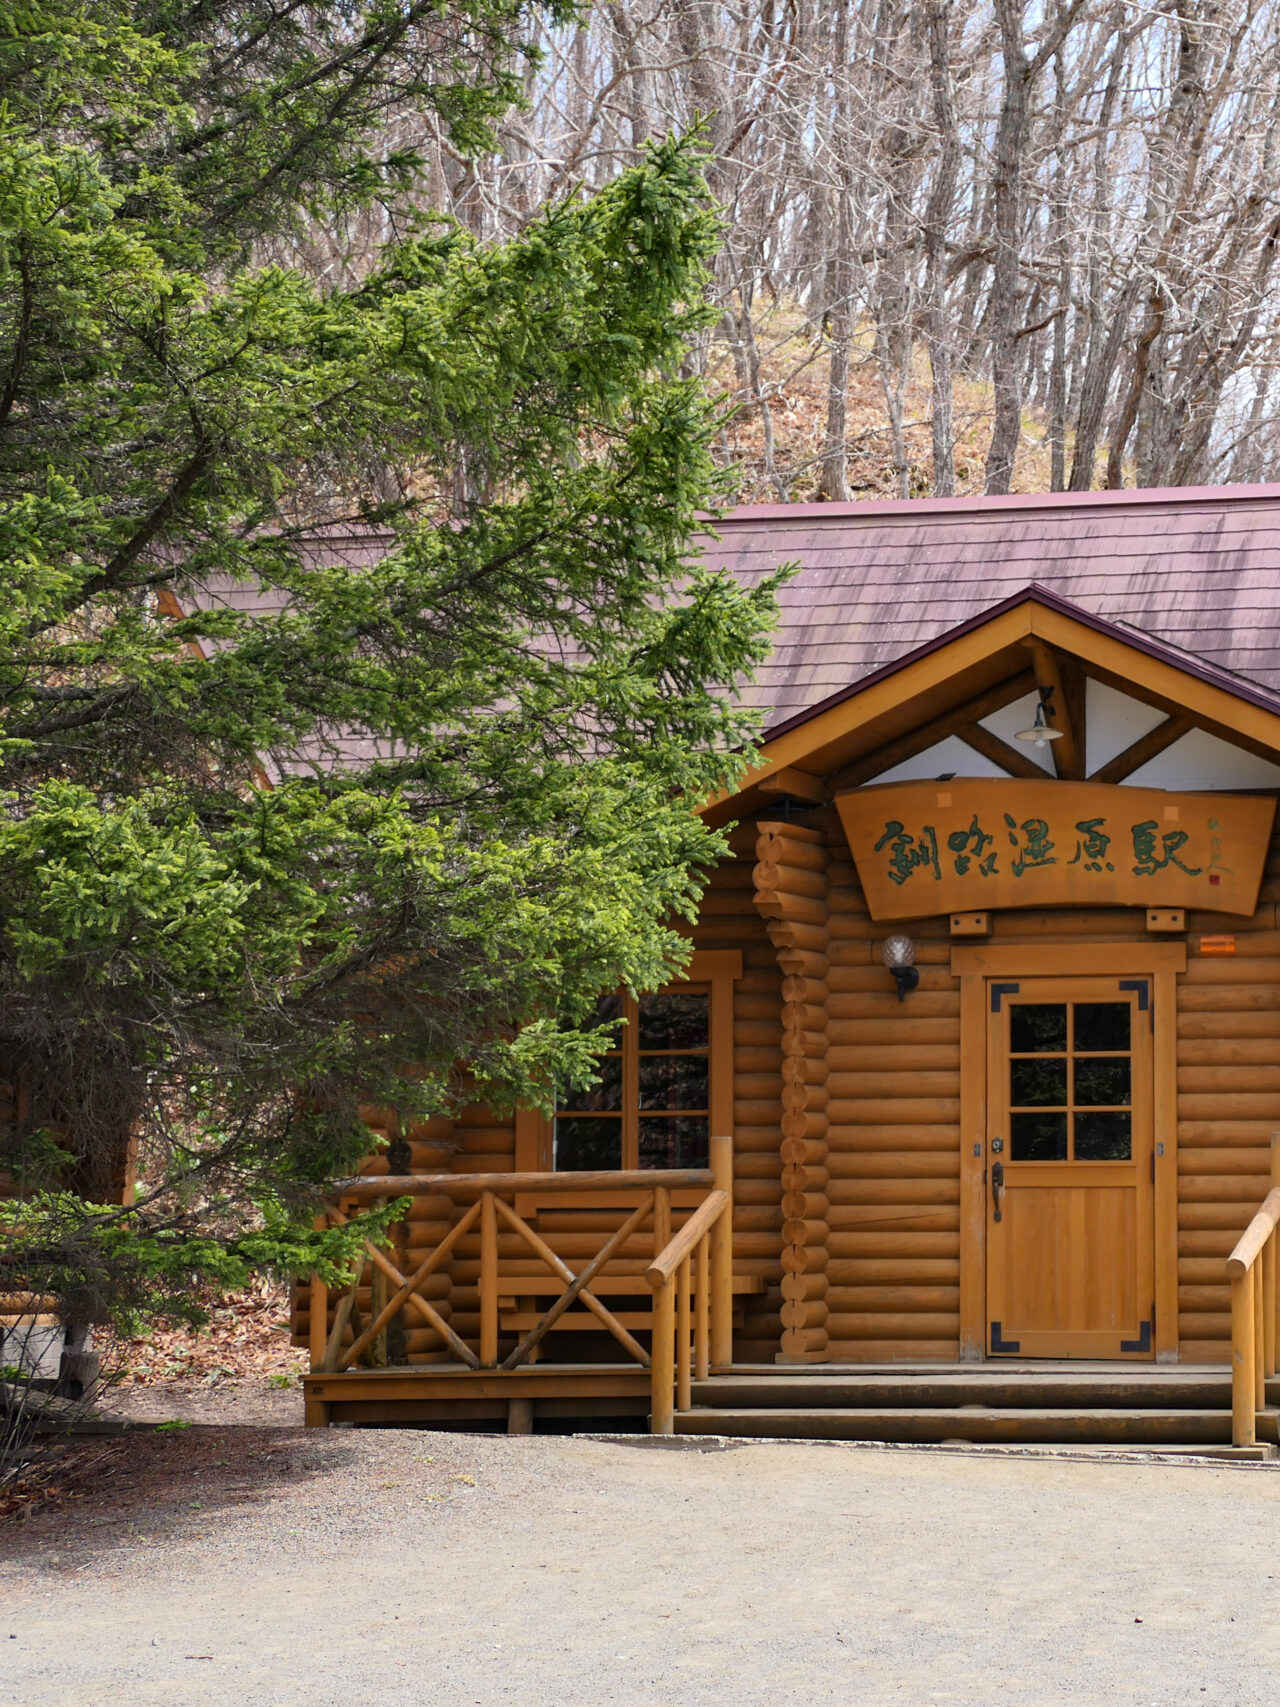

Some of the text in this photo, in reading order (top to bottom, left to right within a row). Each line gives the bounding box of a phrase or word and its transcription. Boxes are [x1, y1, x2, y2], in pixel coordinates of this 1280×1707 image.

[874, 813, 1202, 886] 釧路湿原駅
